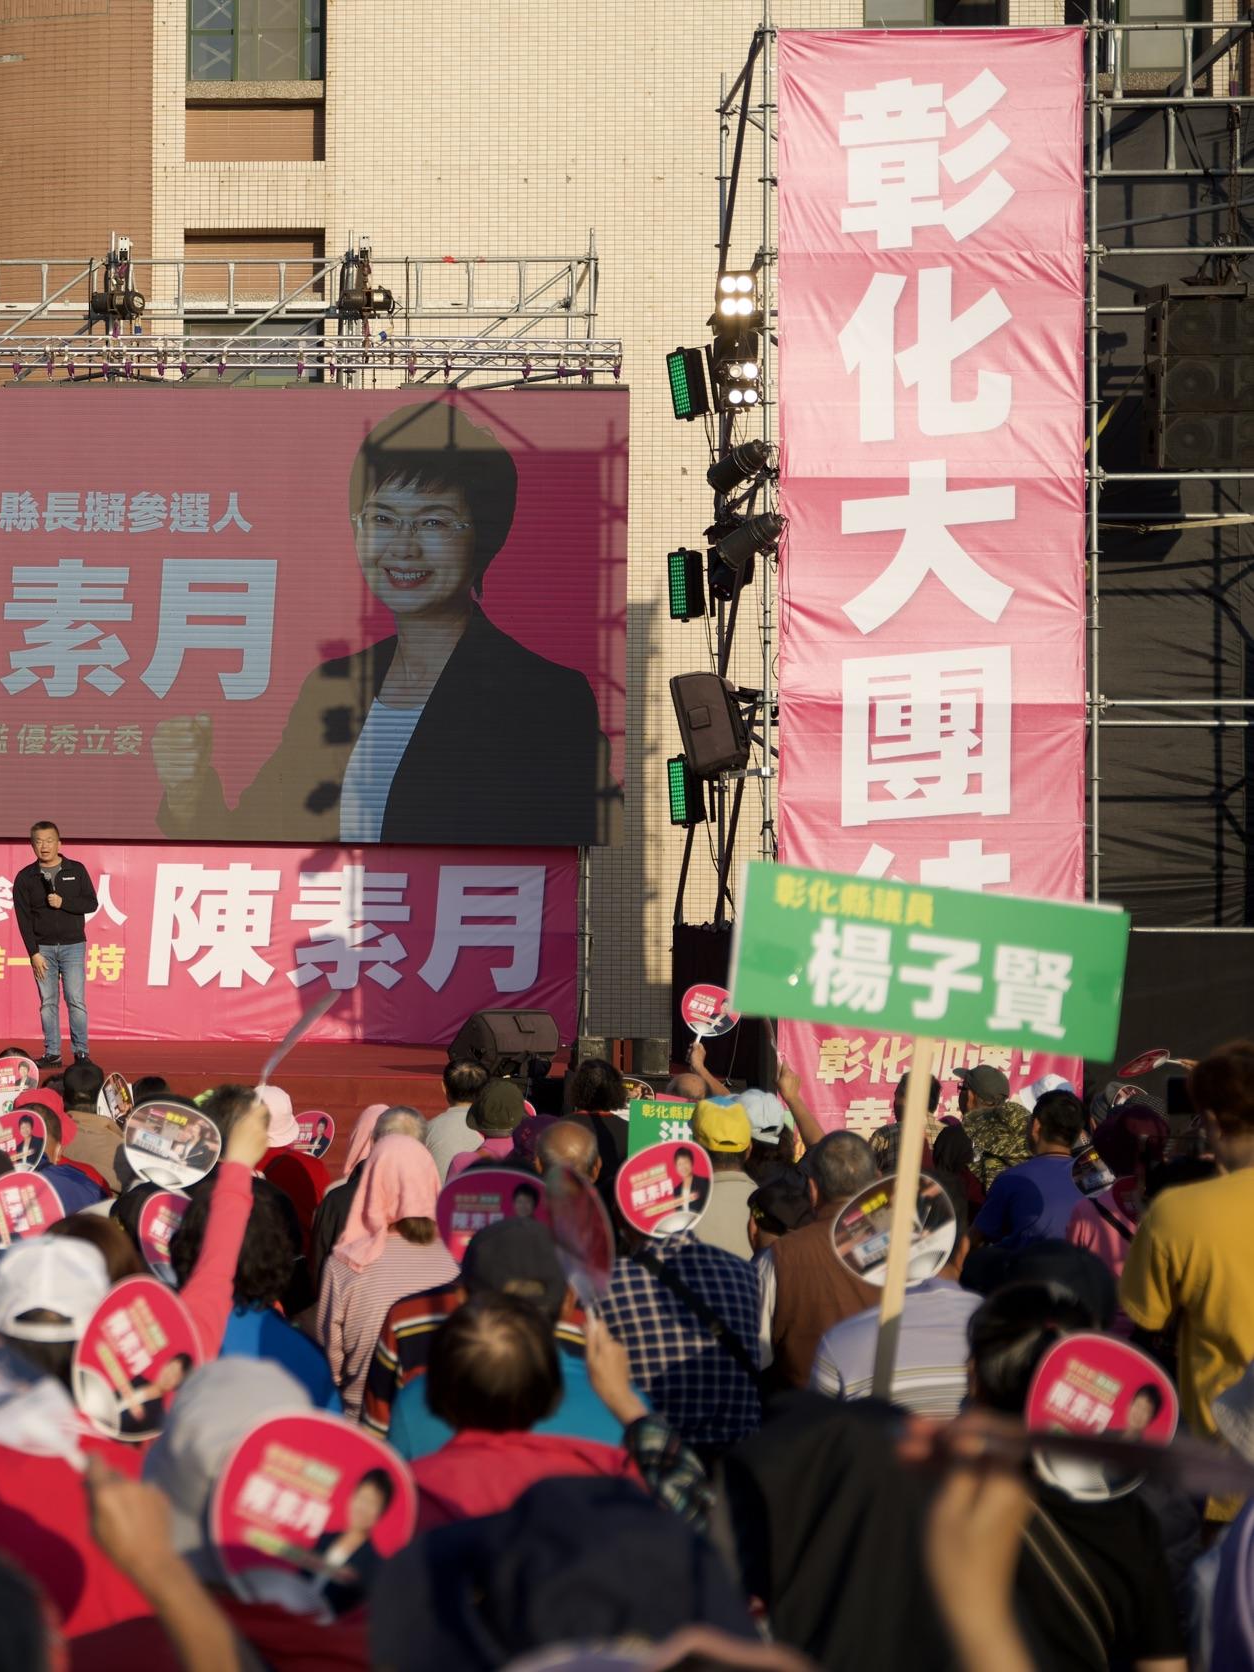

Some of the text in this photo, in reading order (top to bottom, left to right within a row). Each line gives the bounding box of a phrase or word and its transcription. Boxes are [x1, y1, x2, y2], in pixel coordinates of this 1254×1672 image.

[17, 723, 143, 756] 優秀立委
[147, 863, 546, 993] 陳素月
[774, 873, 935, 928] 彰化縣議員
[807, 917, 1074, 1040] 楊子賢
[631, 1179, 674, 1207] 陳素月
